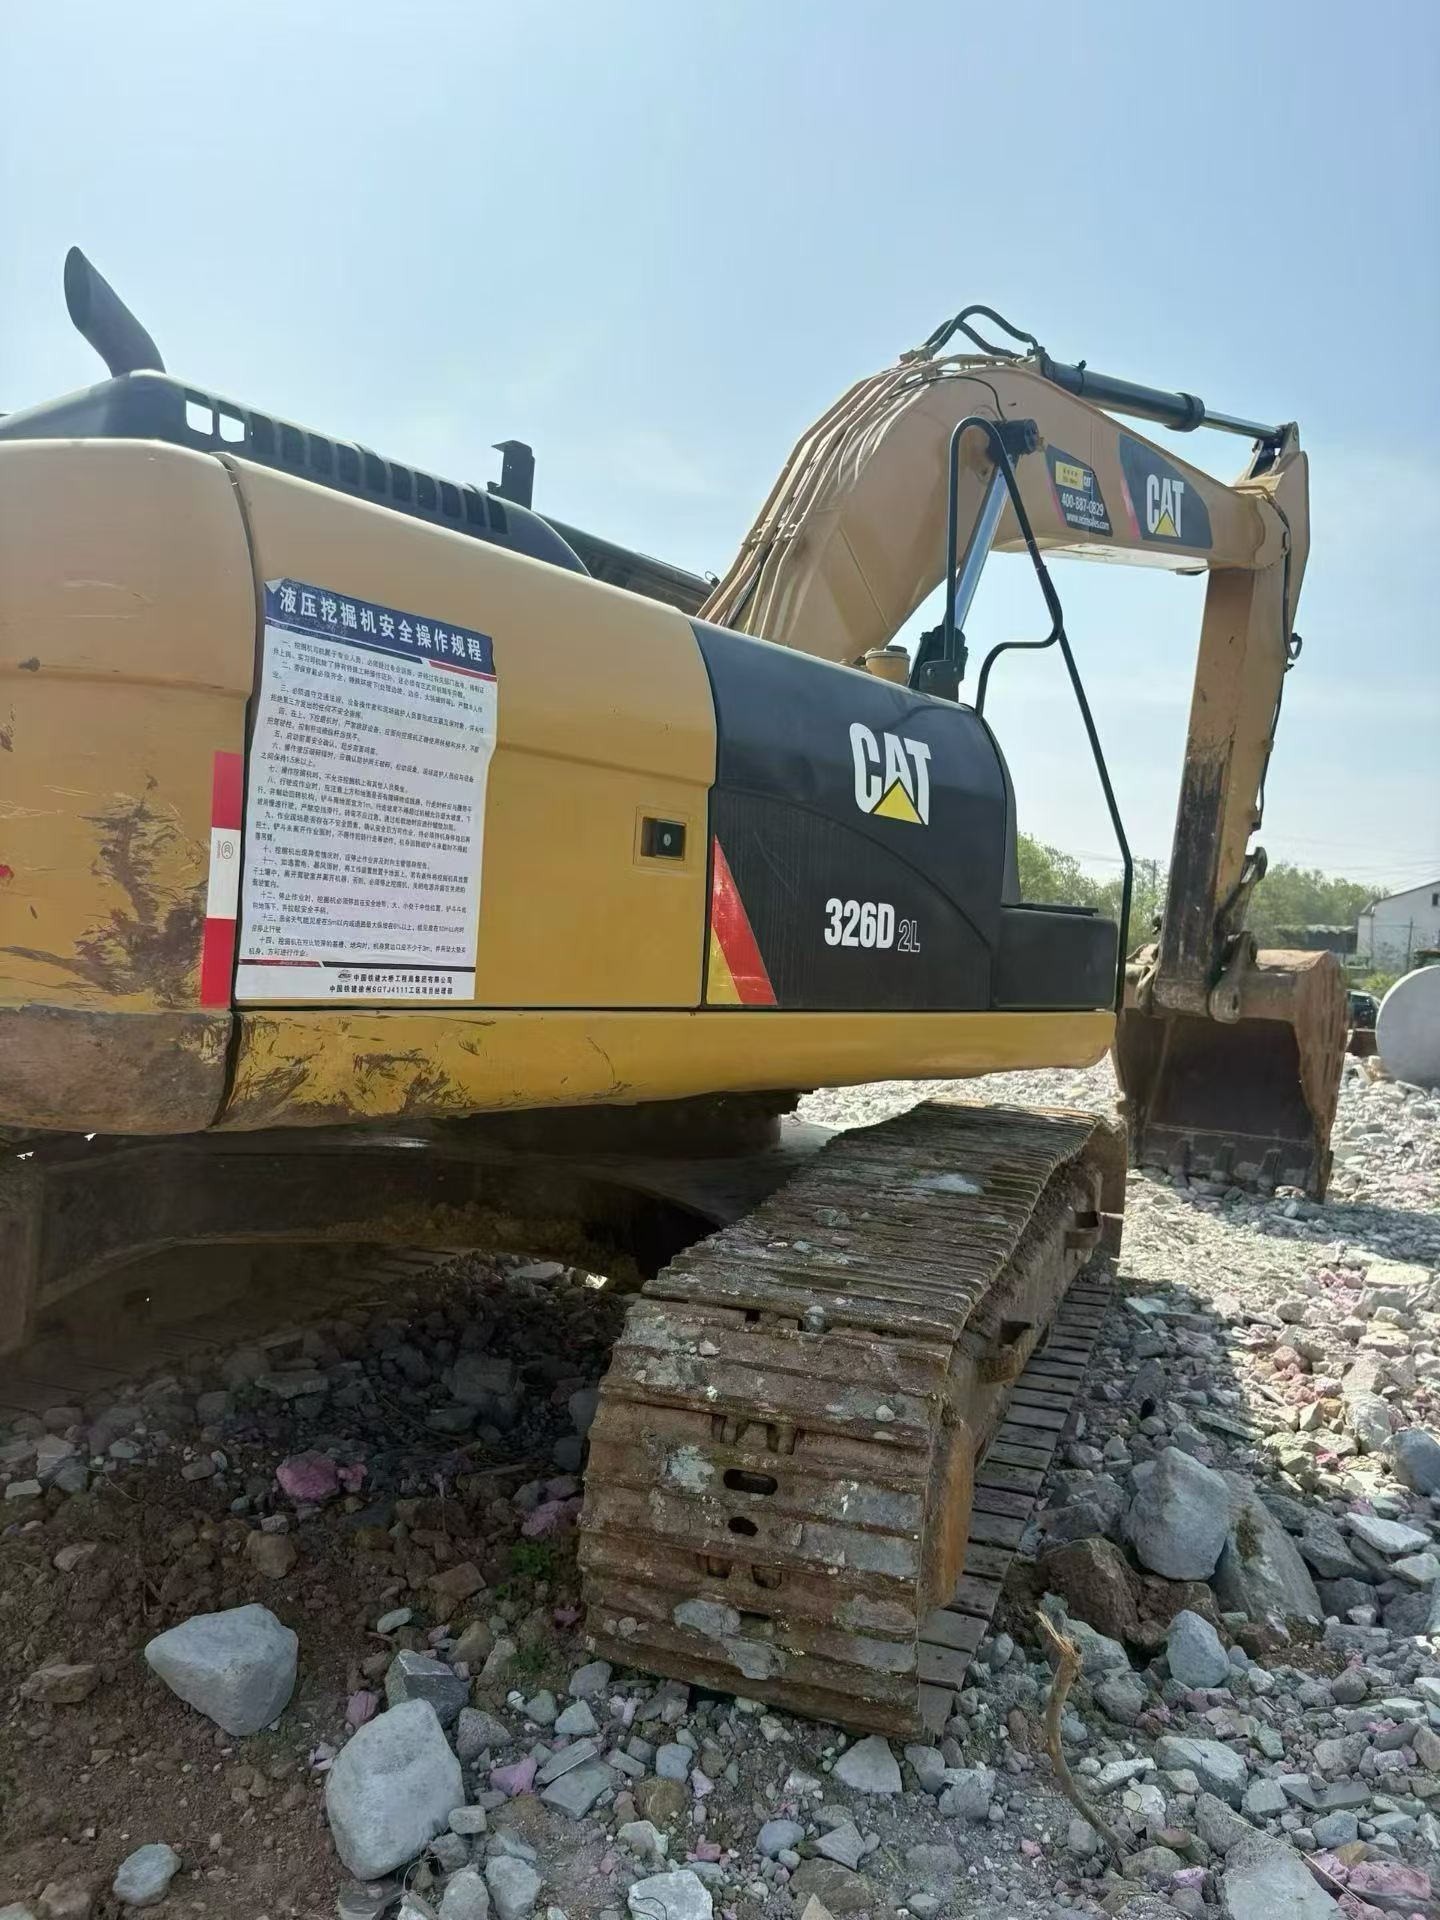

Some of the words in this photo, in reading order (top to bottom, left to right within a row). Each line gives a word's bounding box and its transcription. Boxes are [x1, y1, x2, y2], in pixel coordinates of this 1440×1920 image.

[1146, 474, 1184, 537] CAT
[280, 586, 482, 662] 液压挖掘机安全操作规程
[849, 722, 931, 826] CAT
[824, 897, 895, 950] 326D
[897, 919, 921, 953] 2L
